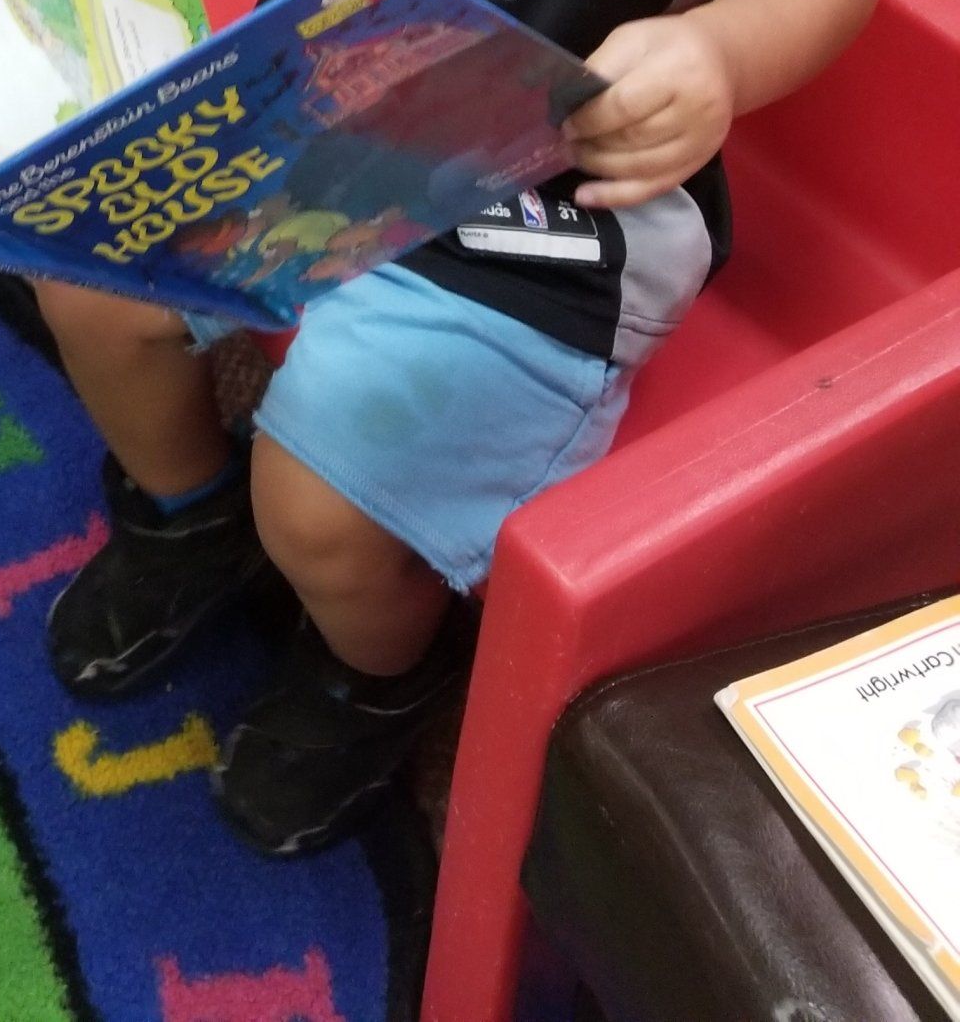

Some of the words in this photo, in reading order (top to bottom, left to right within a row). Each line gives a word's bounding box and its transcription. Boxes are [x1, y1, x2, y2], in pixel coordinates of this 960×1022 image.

[13, 84, 247, 235] SPOOKY
[20, 100, 157, 185] Berenstain
[157, 50, 239, 106] Bears
[92, 145, 286, 264] HOUSE
[99, 146, 219, 225] OLD
[558, 206, 578, 222] 3T
[856, 651, 954, 703] Cartwright
[52, 710, 220, 798] J
